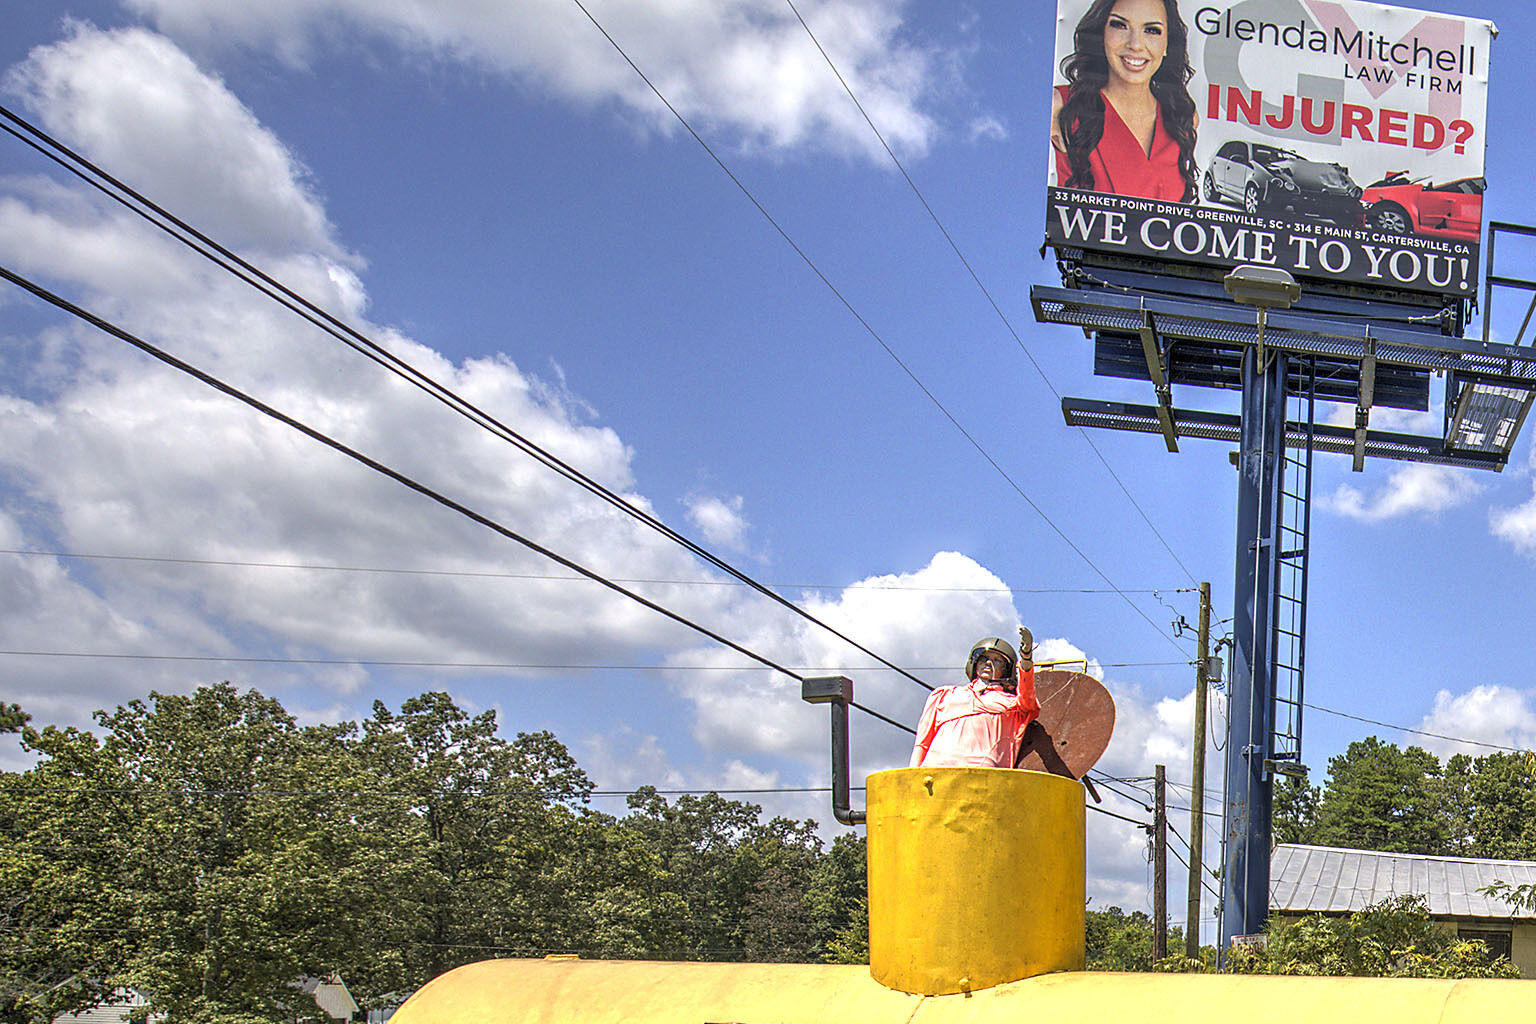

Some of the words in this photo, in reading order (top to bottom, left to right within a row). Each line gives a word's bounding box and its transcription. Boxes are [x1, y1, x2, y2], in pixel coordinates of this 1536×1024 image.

[1344, 63, 1394, 84] LAW
[1406, 73, 1463, 95] FIRM
[1207, 83, 1475, 155] INJURED?
[1054, 205, 1128, 246] WE
[1139, 217, 1277, 266] COME
[1288, 234, 1352, 274] TO
[1361, 244, 1470, 291] YOU!
[1055, 191, 1068, 201] 33
[1071, 193, 1117, 207] MARKET
[1120, 199, 1155, 212] POINT
[1157, 204, 1194, 219] DRIVE,
[1197, 210, 1267, 229] GREENVILLE,
[1269, 217, 1284, 230] SC
[1294, 222, 1312, 234] 314
[1314, 226, 1322, 235] E
[1324, 226, 1352, 239] MAIN
[1354, 231, 1370, 243] ST,
[1372, 233, 1452, 254] CARTERSVILLE,
[1454, 244, 1470, 255] GA
